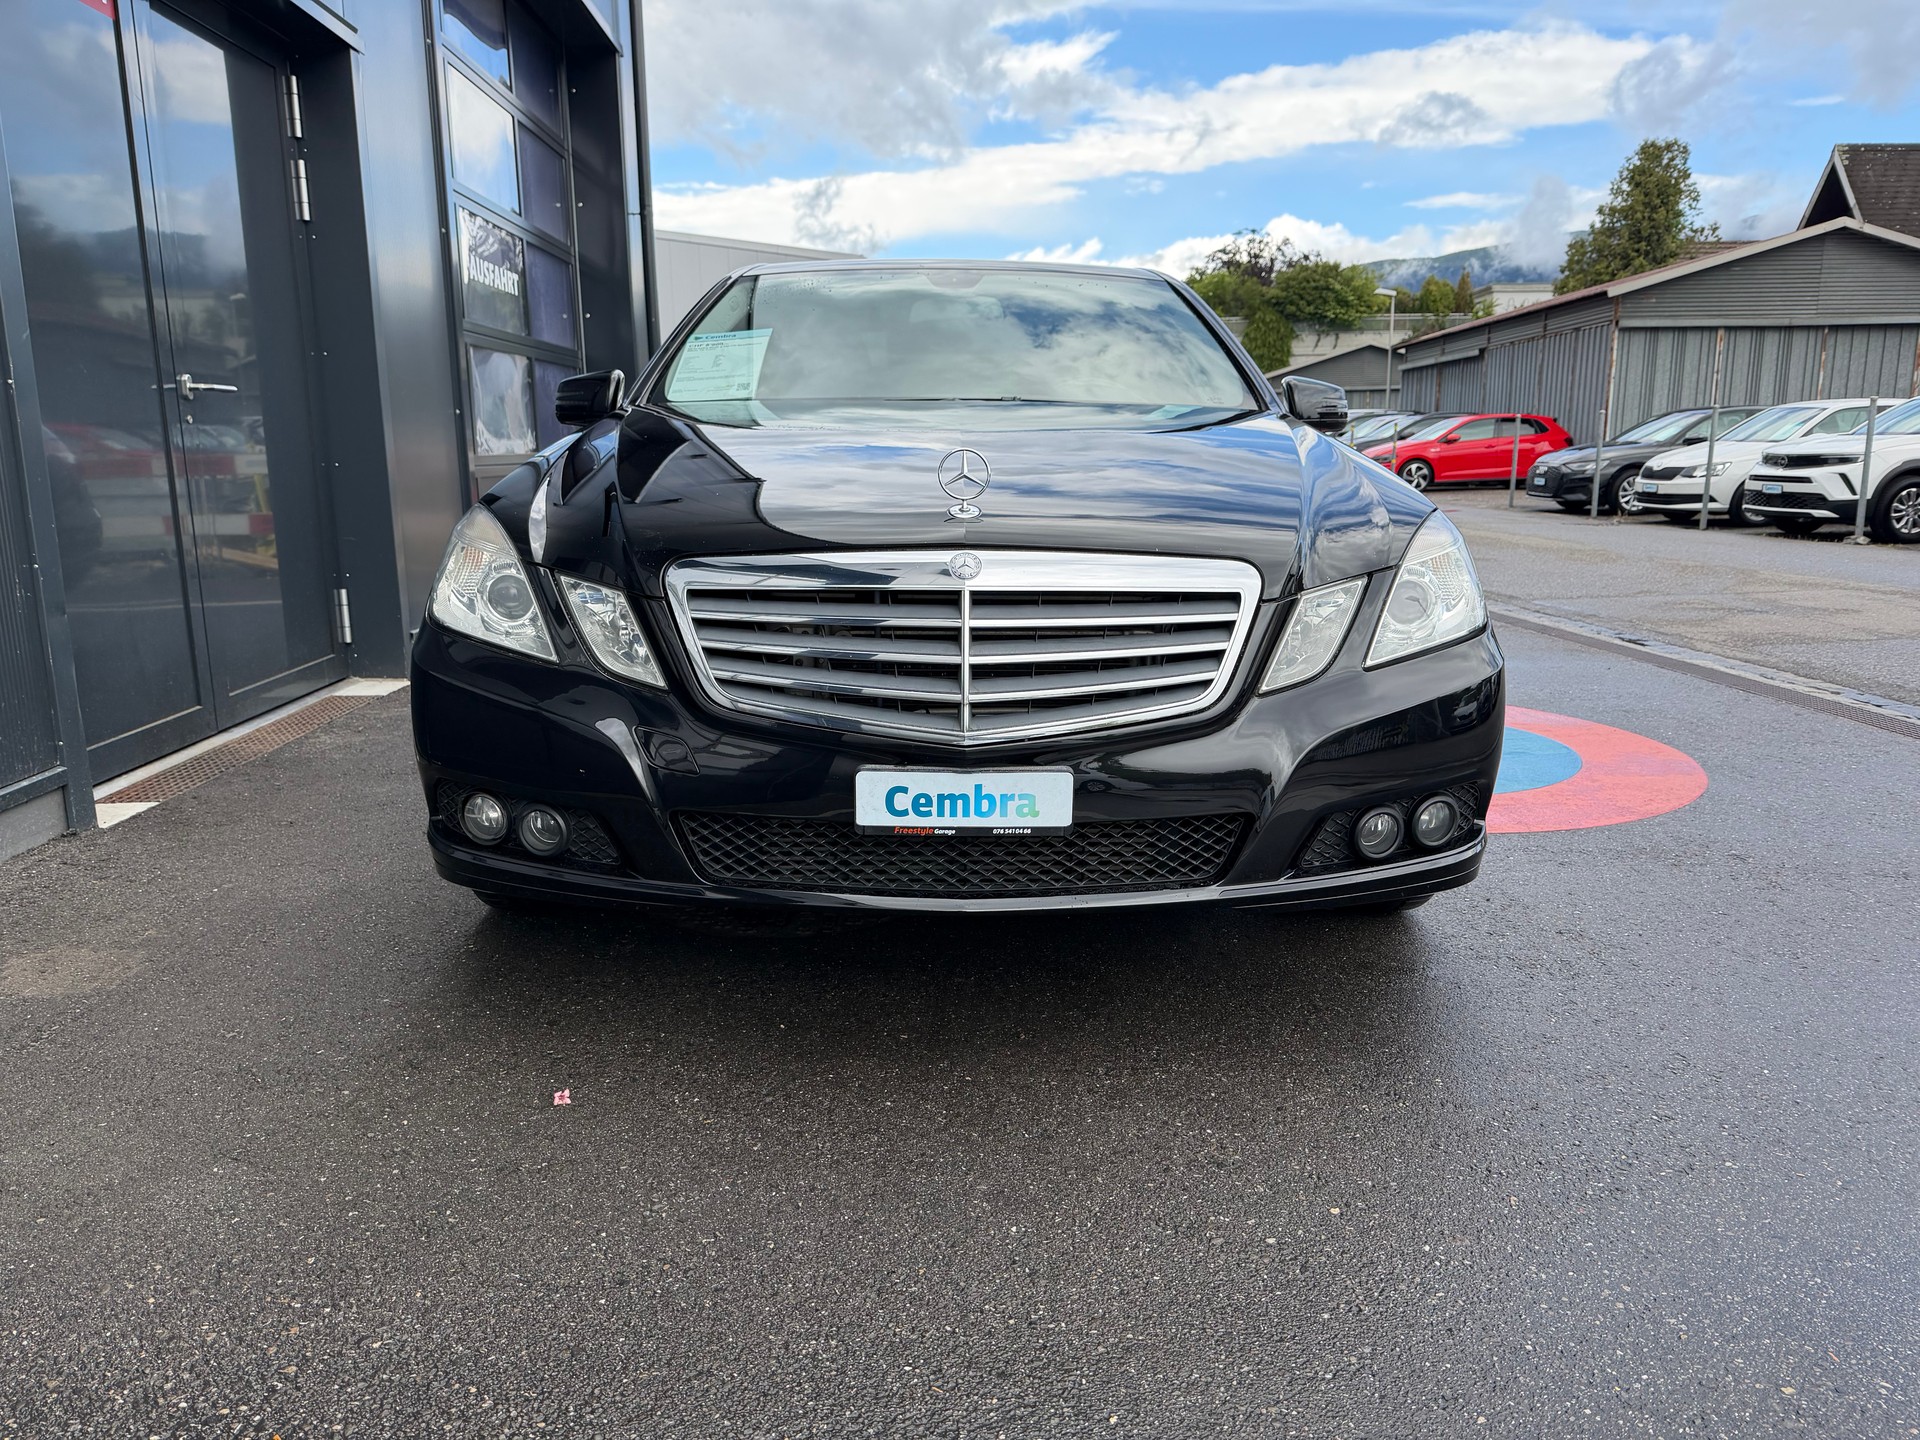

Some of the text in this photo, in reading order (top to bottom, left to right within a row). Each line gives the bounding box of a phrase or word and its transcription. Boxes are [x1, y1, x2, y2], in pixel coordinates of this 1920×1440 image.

[470, 255, 519, 296] AUSFAHRT
[885, 783, 1040, 818] Cembra
[894, 827, 934, 836] Freestyle
[934, 828, 956, 836] Garage
